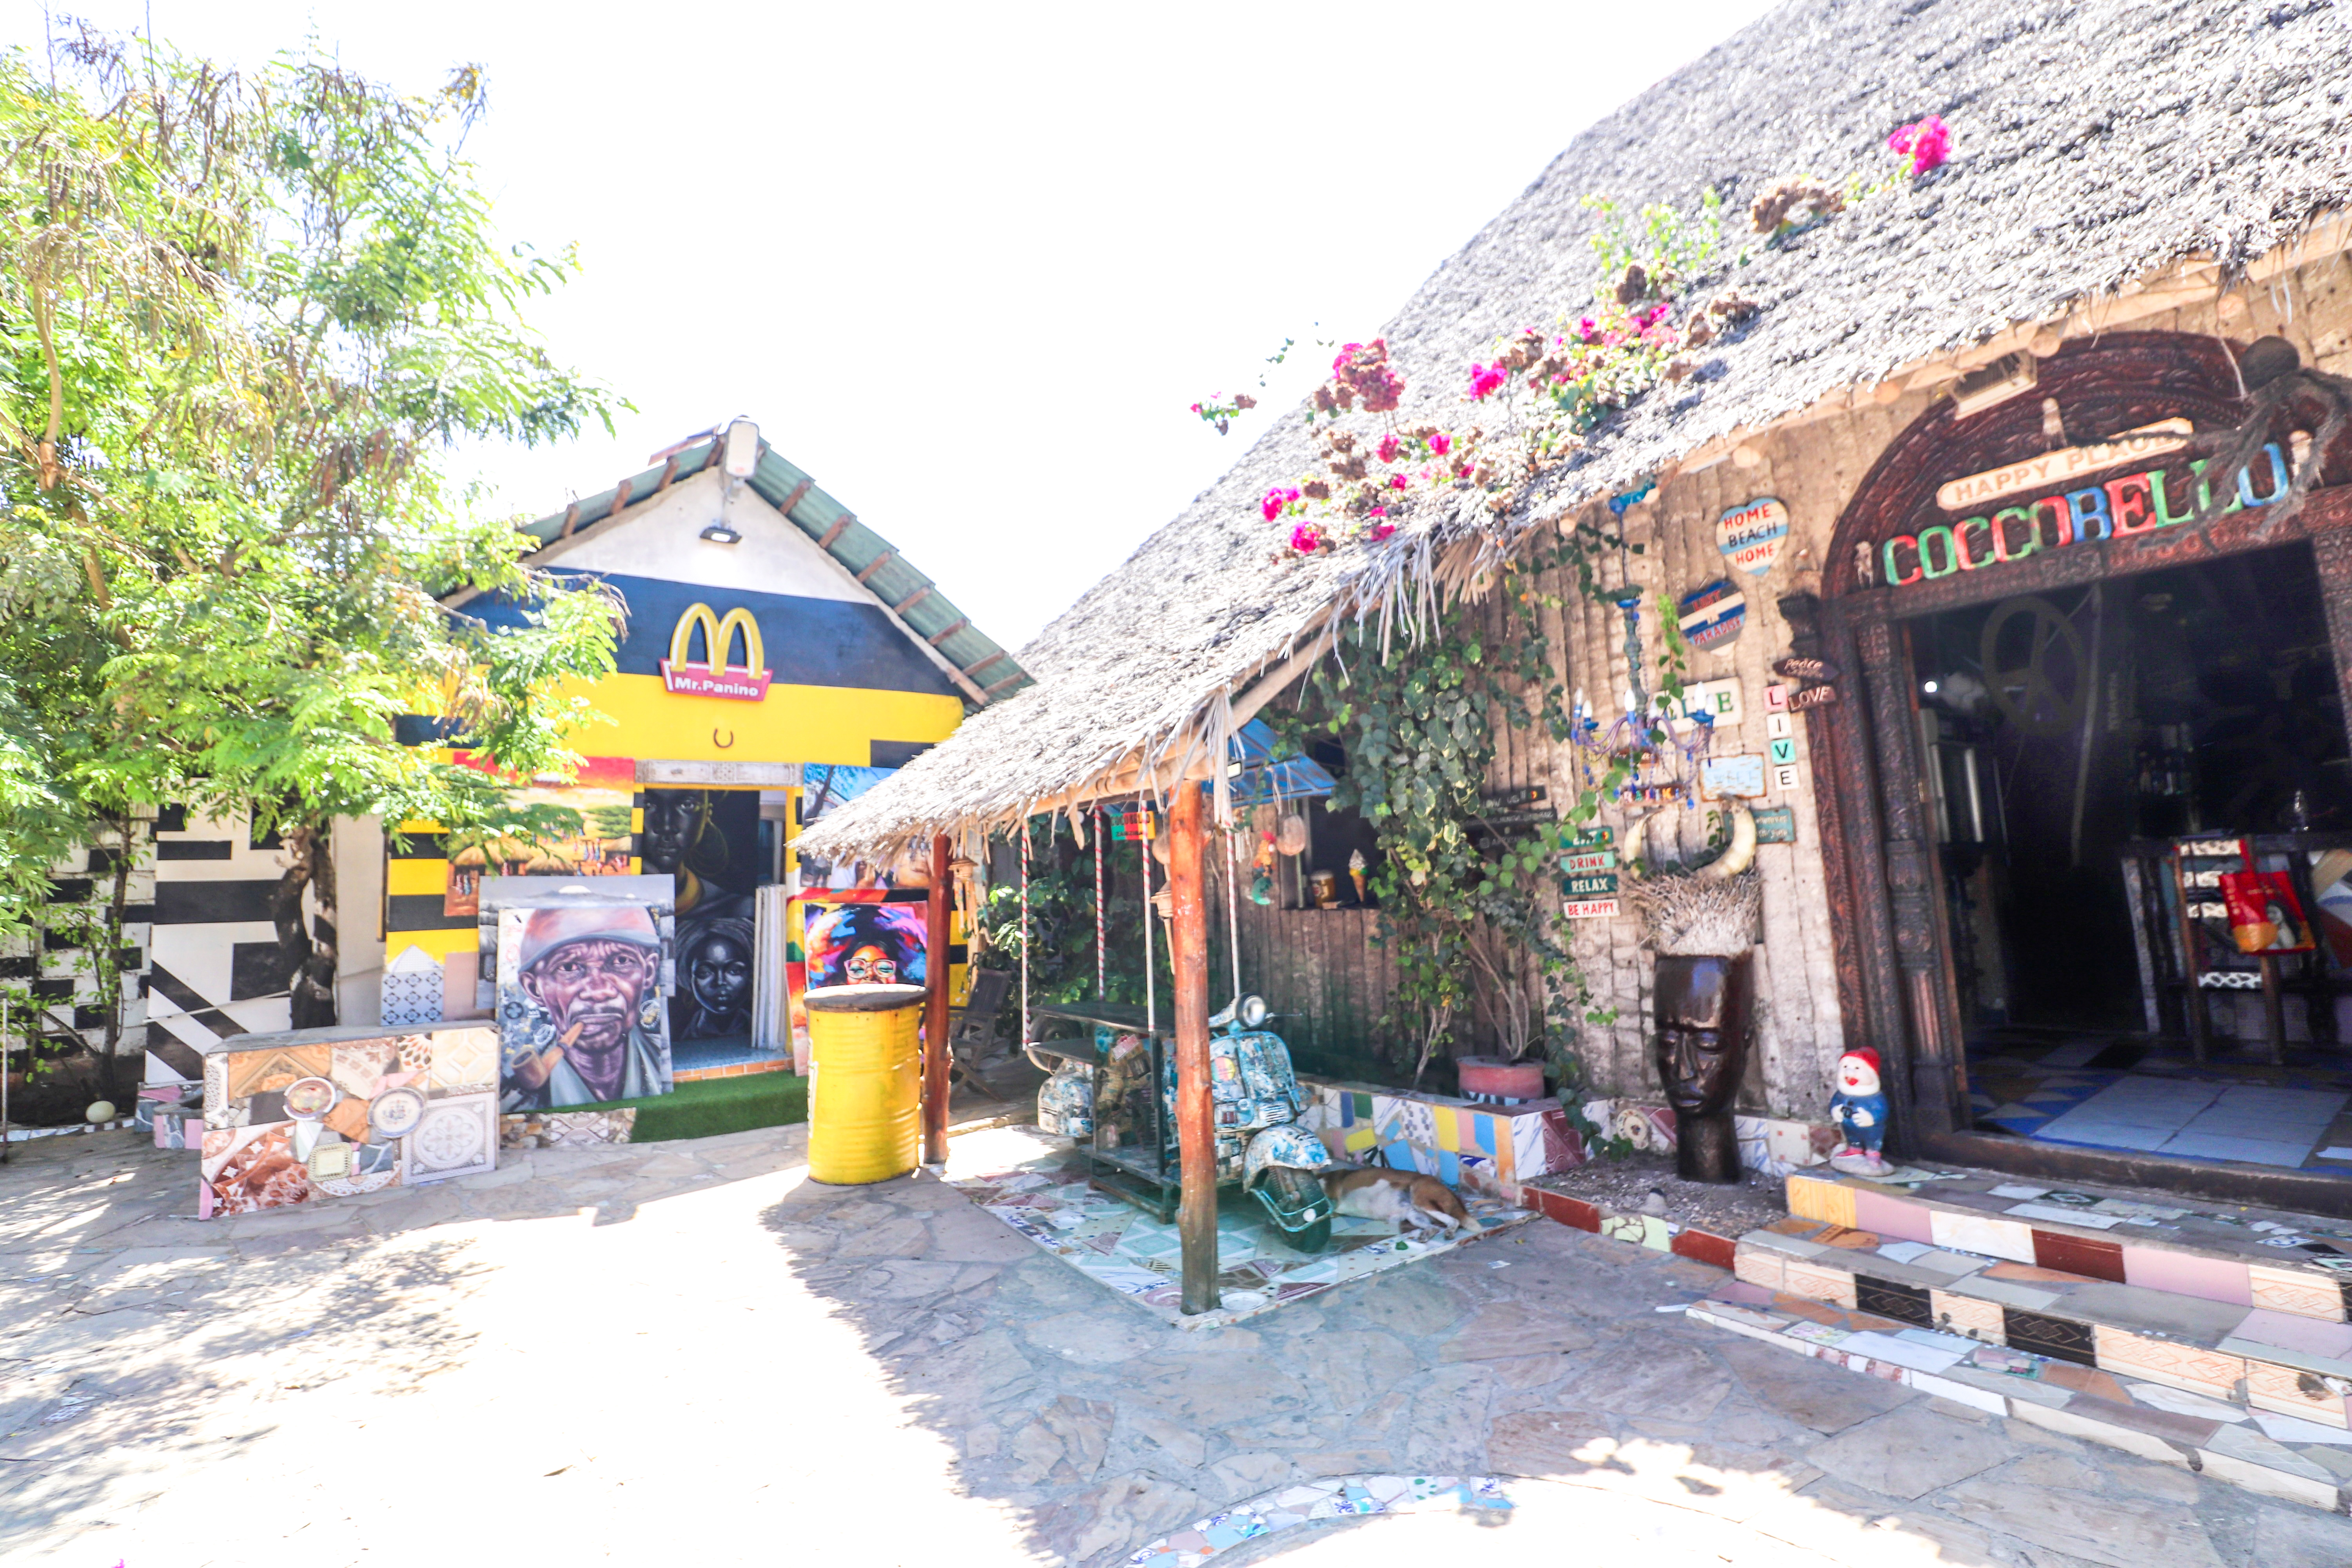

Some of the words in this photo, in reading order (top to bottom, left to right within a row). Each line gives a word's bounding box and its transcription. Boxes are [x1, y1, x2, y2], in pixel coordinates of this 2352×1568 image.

[1955, 459, 2051, 502] HAPPY
[1723, 503, 1771, 530] HOME
[1728, 521, 1777, 548] BEACH
[1735, 543, 1773, 565] HOME
[1693, 590, 1721, 612] LOST
[674, 676, 759, 697] Mr.Panino
[1788, 686, 1836, 711] LOVE
[1570, 854, 1604, 869] DRINK
[1572, 878, 1608, 893] RELAX
[1568, 904, 1579, 916] BE
[1583, 902, 1613, 915] HAPPY
